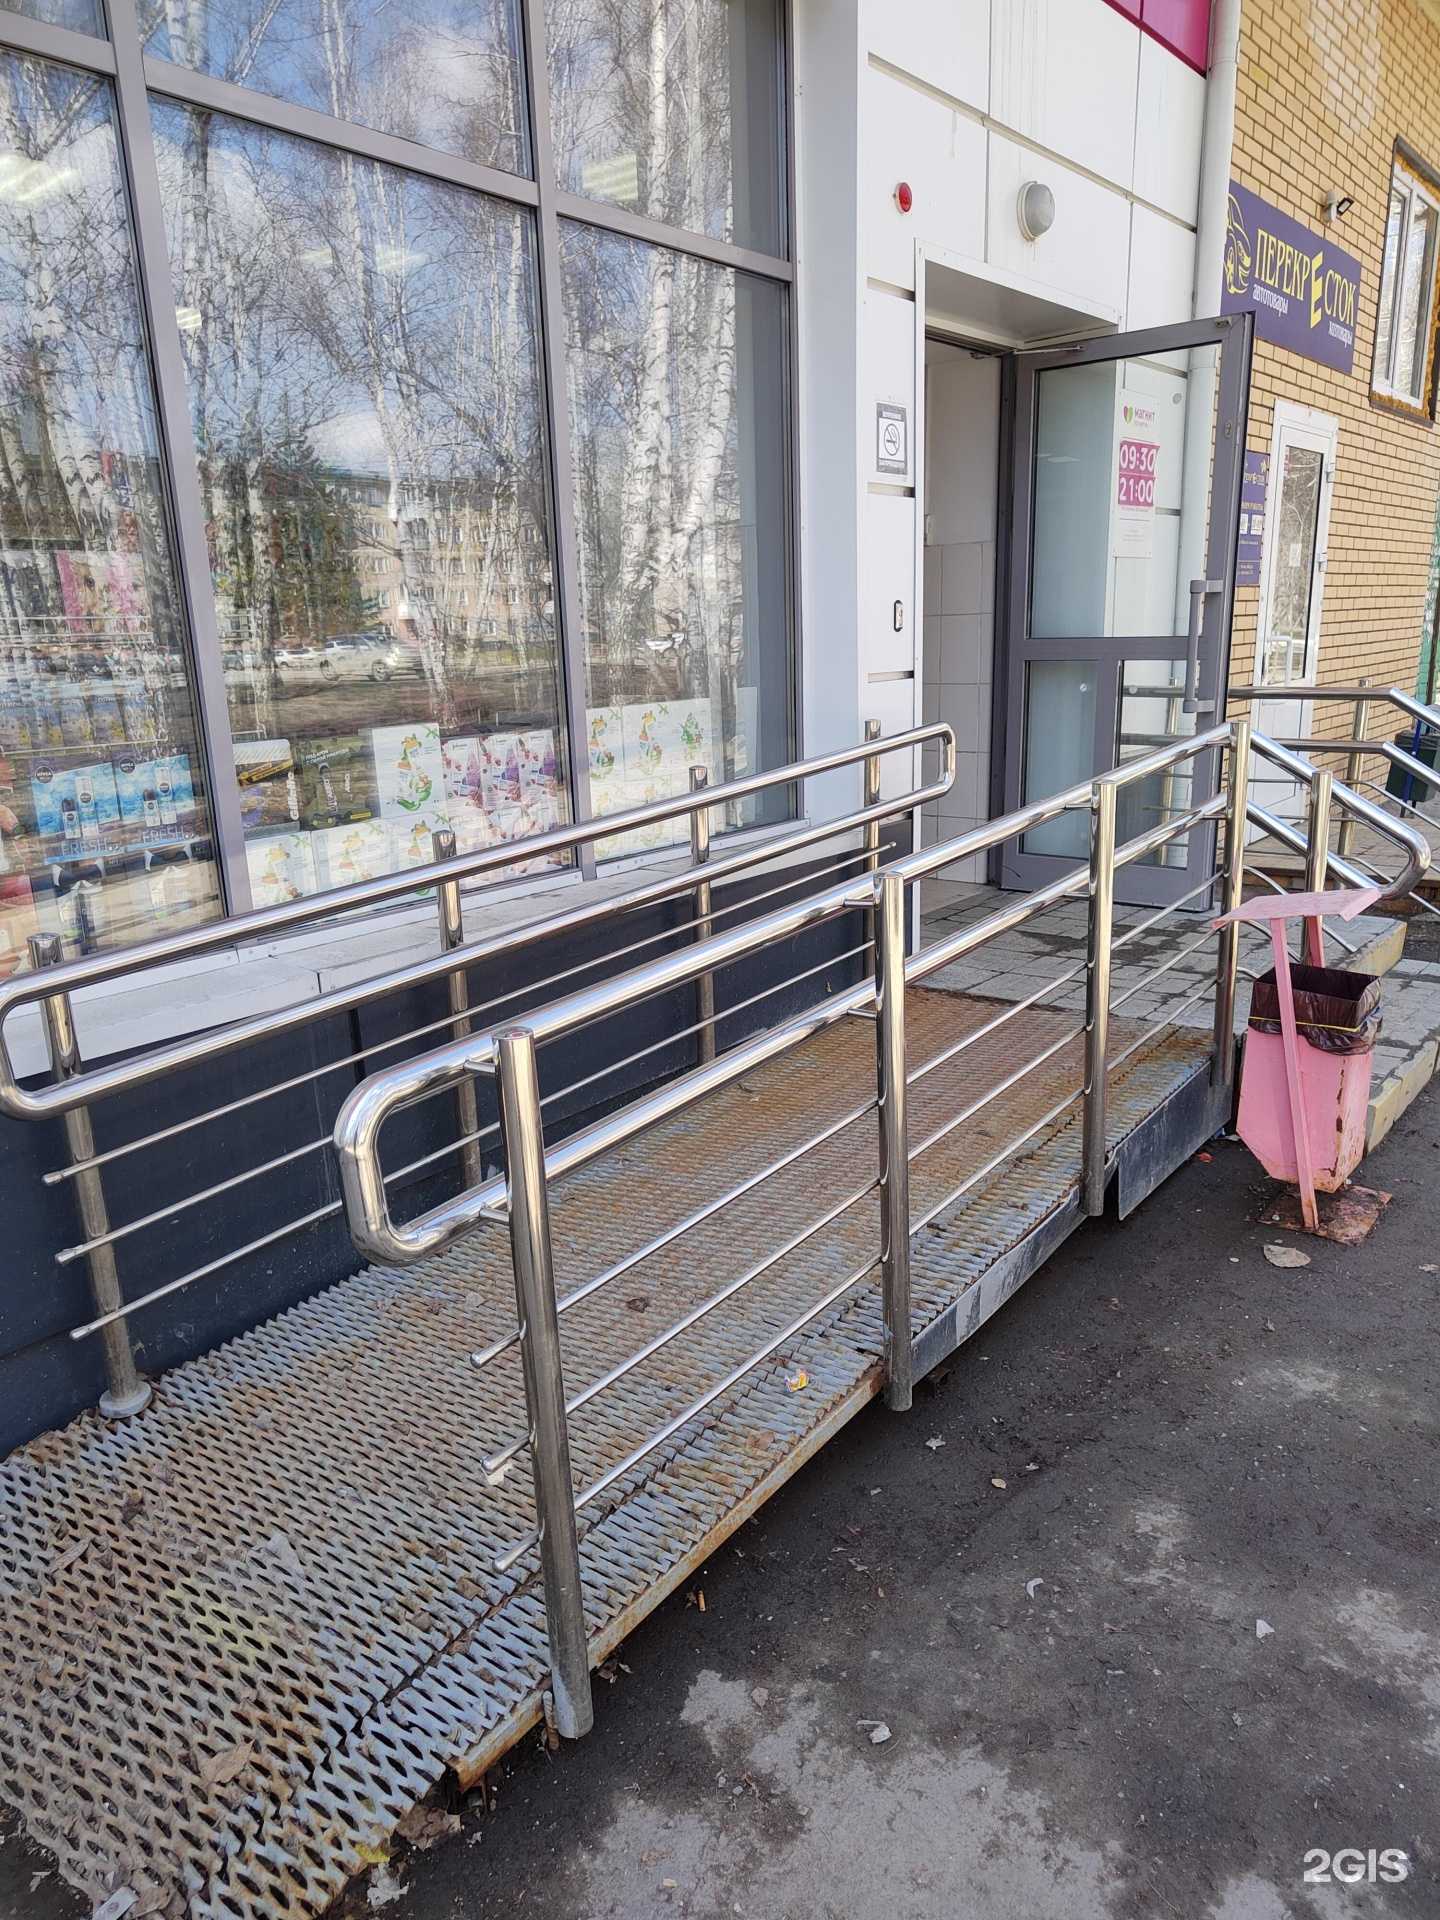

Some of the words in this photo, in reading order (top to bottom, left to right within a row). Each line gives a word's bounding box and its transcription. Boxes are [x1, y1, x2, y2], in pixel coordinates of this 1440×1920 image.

[1252, 284, 1289, 317] автотовары
[1120, 444, 1157, 472] 09:30
[1119, 477, 1153, 503] 21:00
